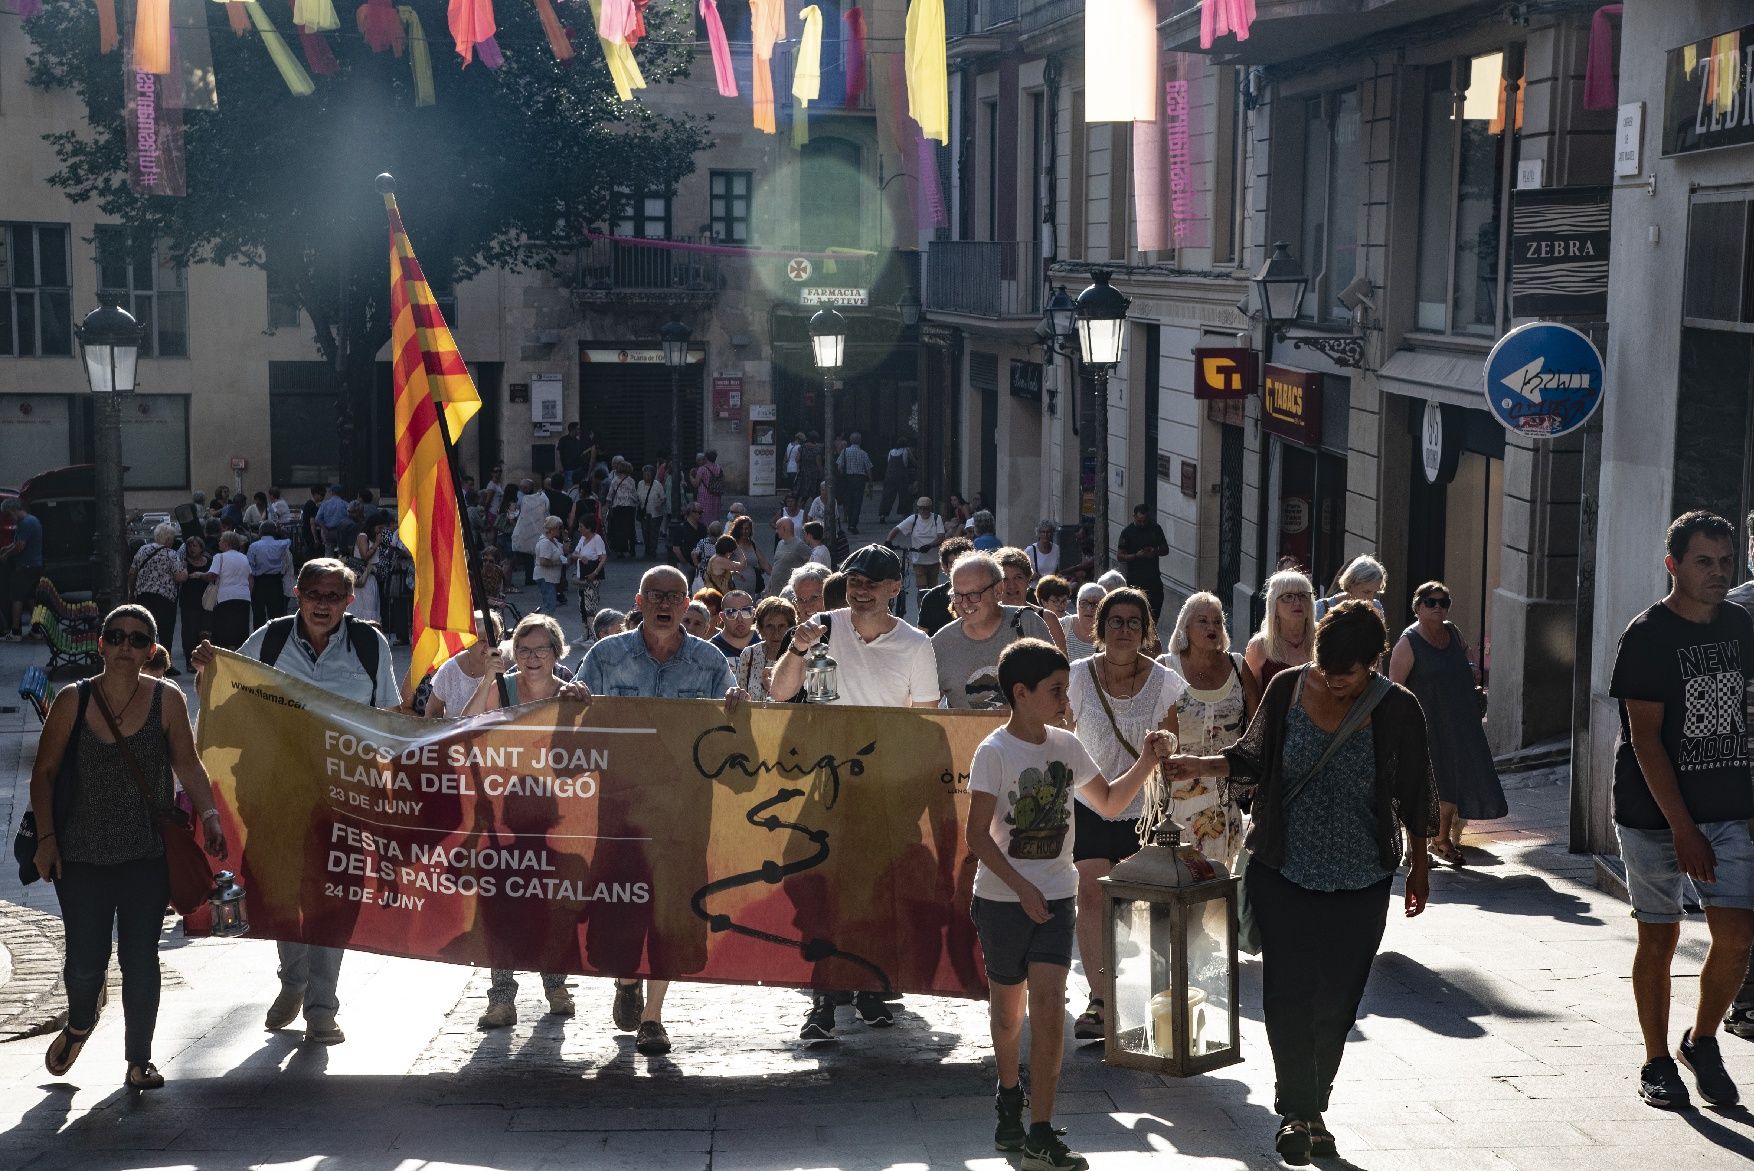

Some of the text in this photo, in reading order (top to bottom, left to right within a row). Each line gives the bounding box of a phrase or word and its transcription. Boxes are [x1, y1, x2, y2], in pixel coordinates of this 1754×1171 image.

[1526, 240, 1595, 258] ZEBRA
[807, 288, 862, 296] FARMACIA
[1274, 381, 1303, 416] TABACS
[1677, 640, 1742, 679] NEW
[325, 730, 609, 771] FOCS DE SANT JOAN
[692, 726, 877, 810] Canigó
[325, 758, 597, 798] FLAMA DEL CANIGÓ
[329, 785, 423, 816] 23 DE JUNY
[332, 822, 556, 870] FESTA NACIONAL
[327, 850, 650, 904] DELS PAÏSOS CATALANS
[324, 882, 426, 912] 24 DE JUNY
